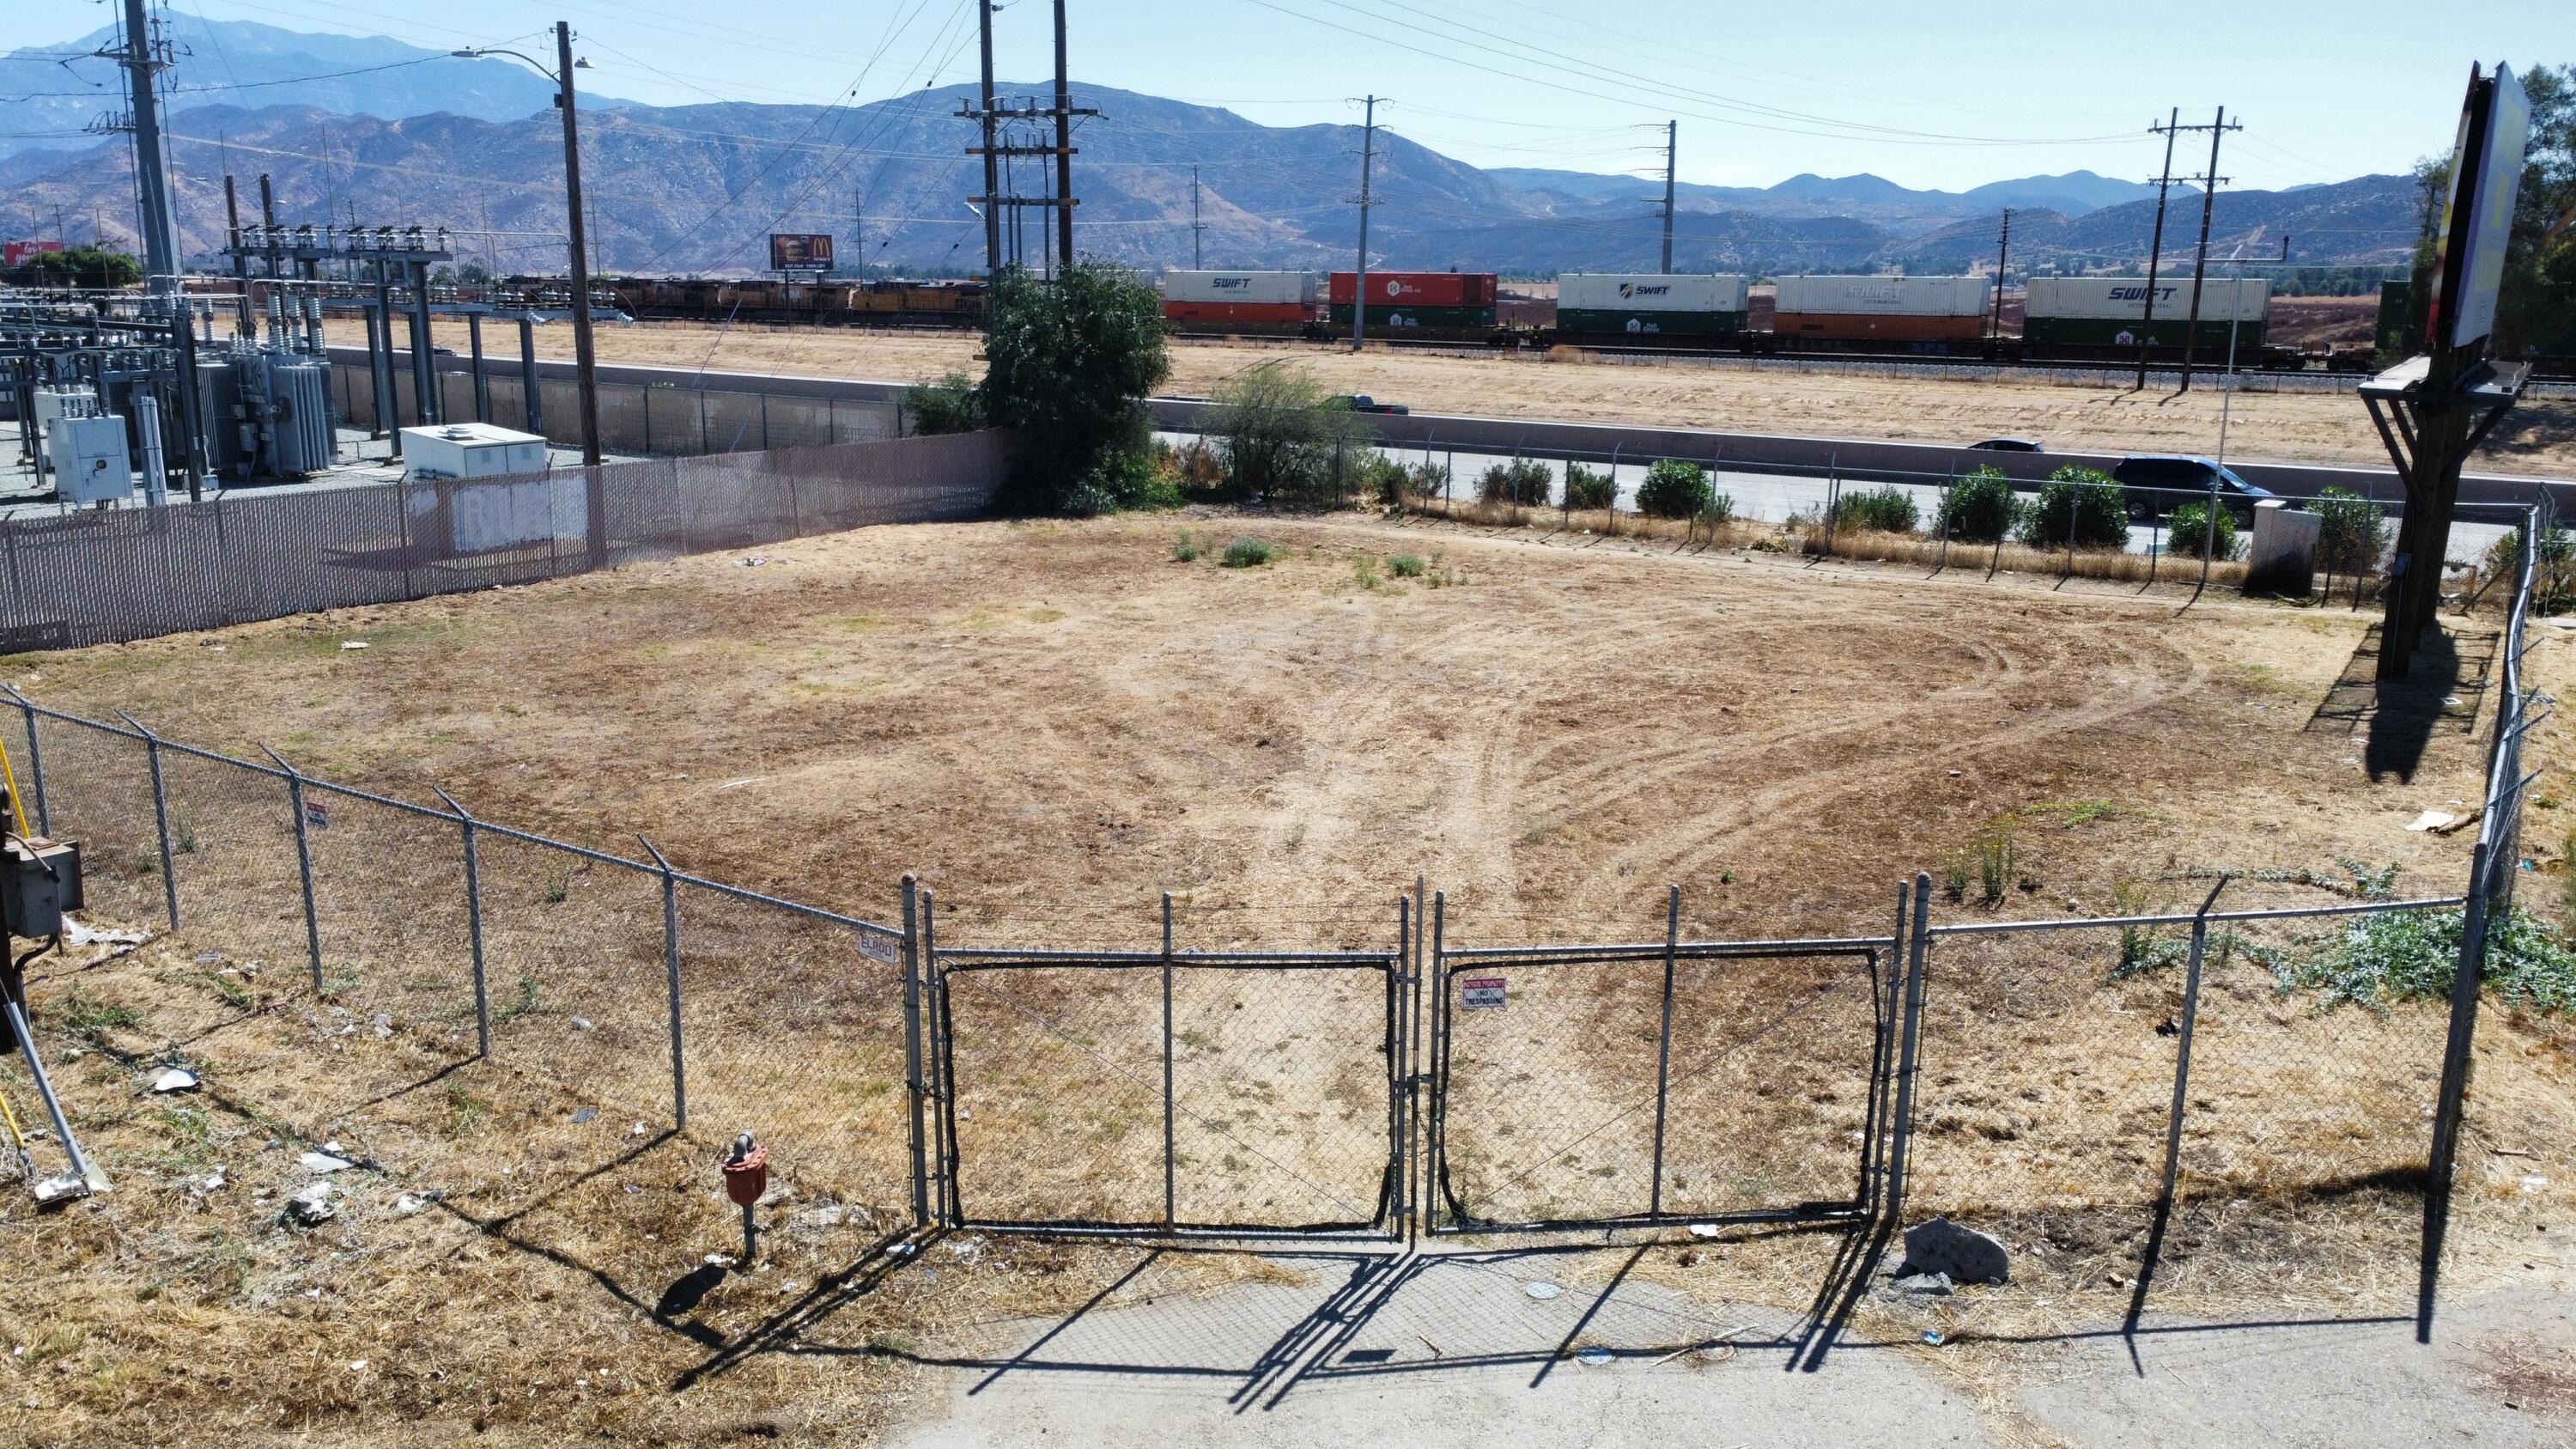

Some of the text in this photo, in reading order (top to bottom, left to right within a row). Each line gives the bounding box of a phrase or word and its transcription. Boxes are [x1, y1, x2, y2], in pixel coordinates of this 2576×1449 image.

[1212, 277, 1251, 288] SWIFT
[1636, 285, 1671, 295] SWIFT
[1465, 996, 1504, 1006] TRESPASSING
